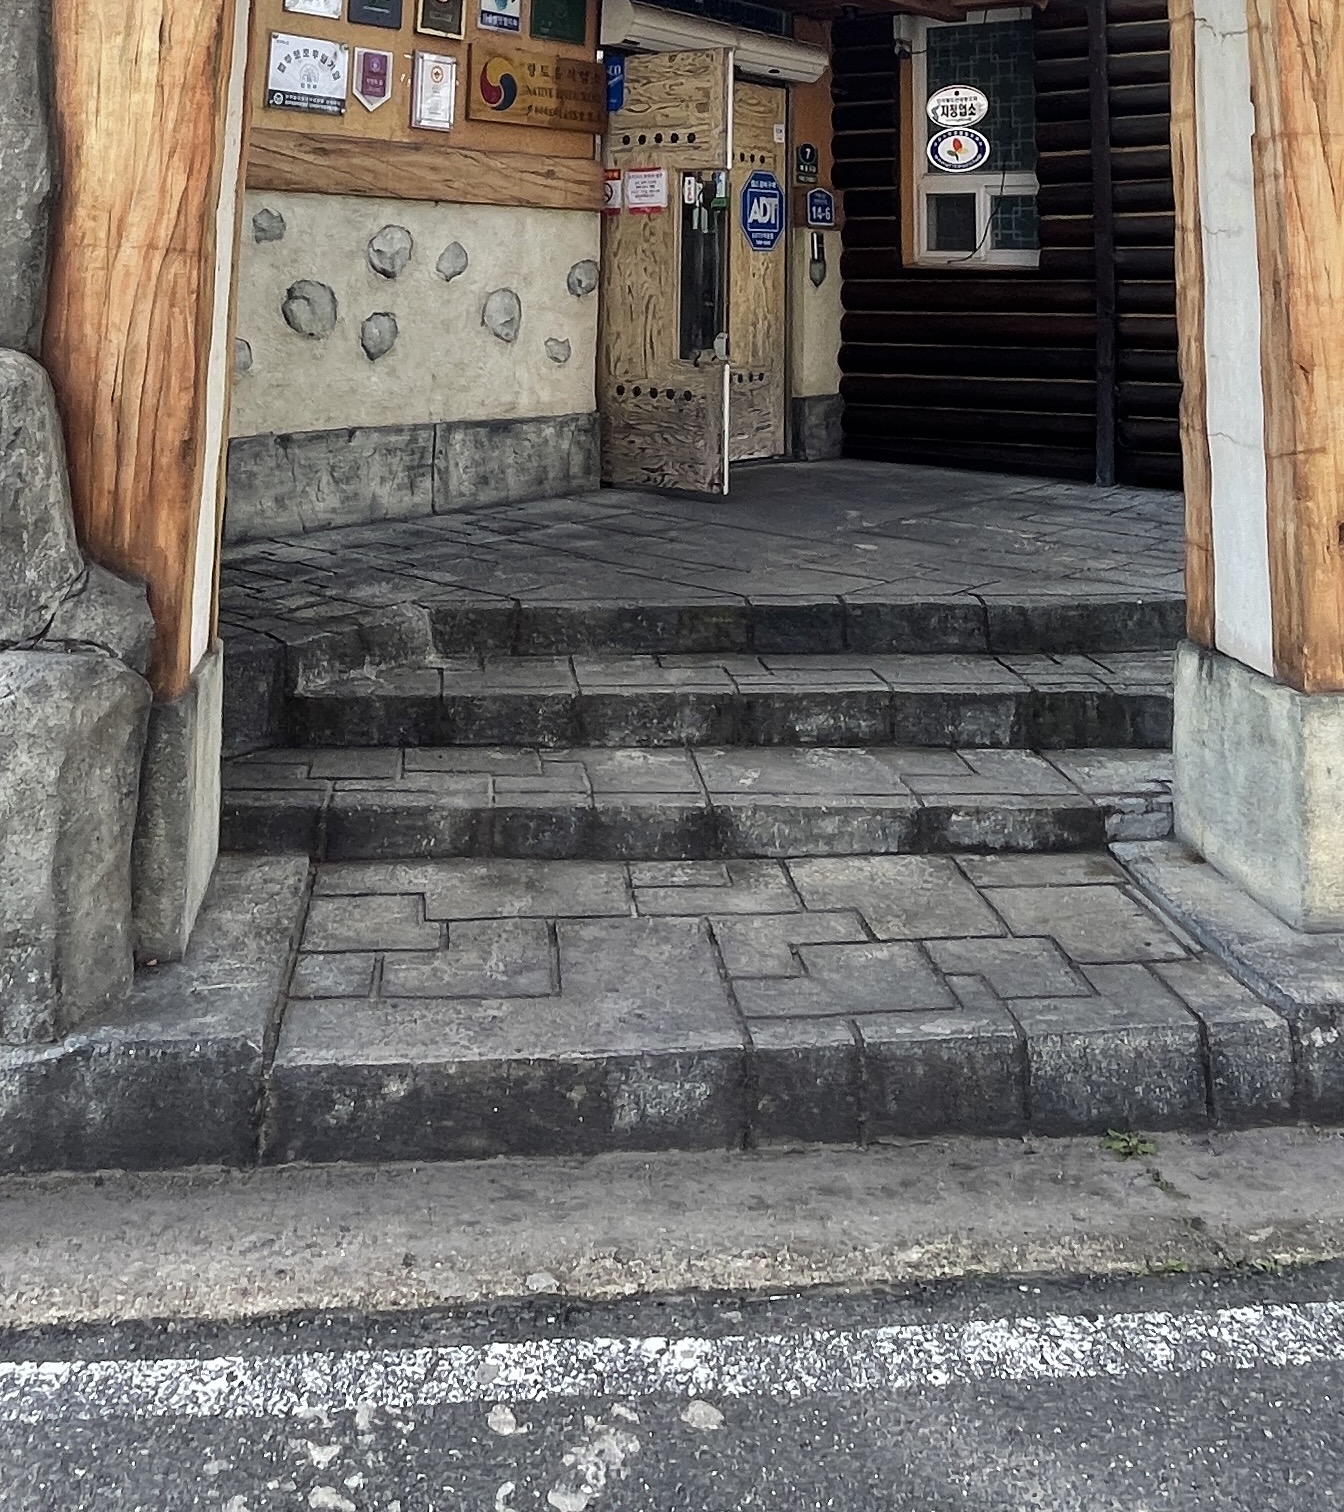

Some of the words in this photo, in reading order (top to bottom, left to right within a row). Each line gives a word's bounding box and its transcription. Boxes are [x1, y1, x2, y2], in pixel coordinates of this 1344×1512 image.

[940, 102, 977, 119] 지정업소
[748, 196, 779, 224] ADT
[811, 205, 831, 221] 14-6
